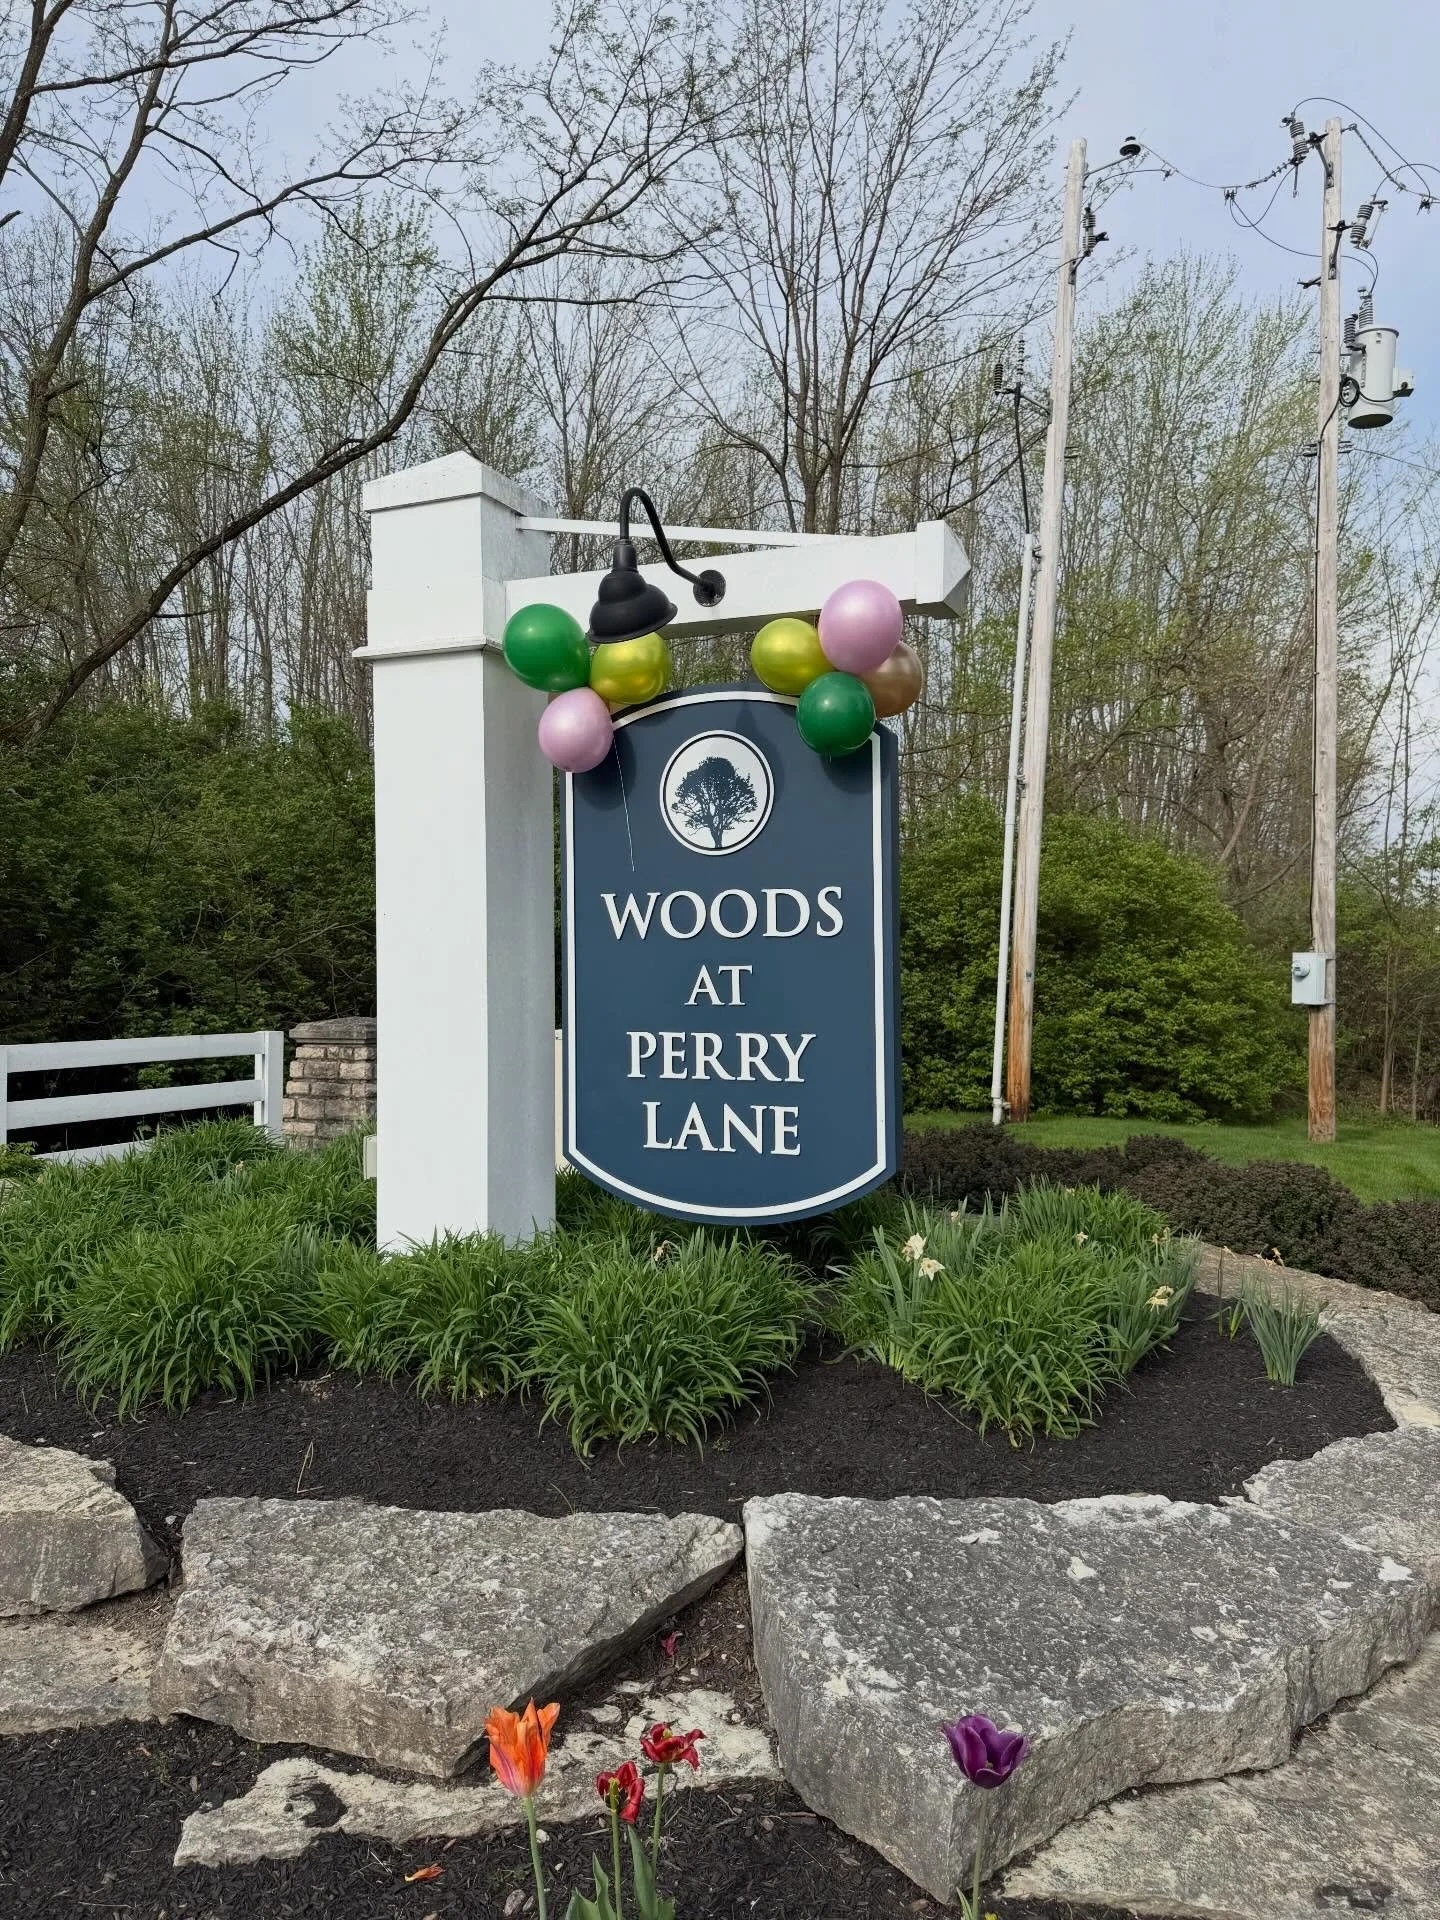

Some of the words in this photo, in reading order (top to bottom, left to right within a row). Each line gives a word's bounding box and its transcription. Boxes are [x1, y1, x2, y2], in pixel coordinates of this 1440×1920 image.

[601, 886, 844, 940] WOODS
[685, 965, 753, 1006] AT
[626, 1031, 816, 1083] PERRY
[643, 1101, 801, 1156] LANE
